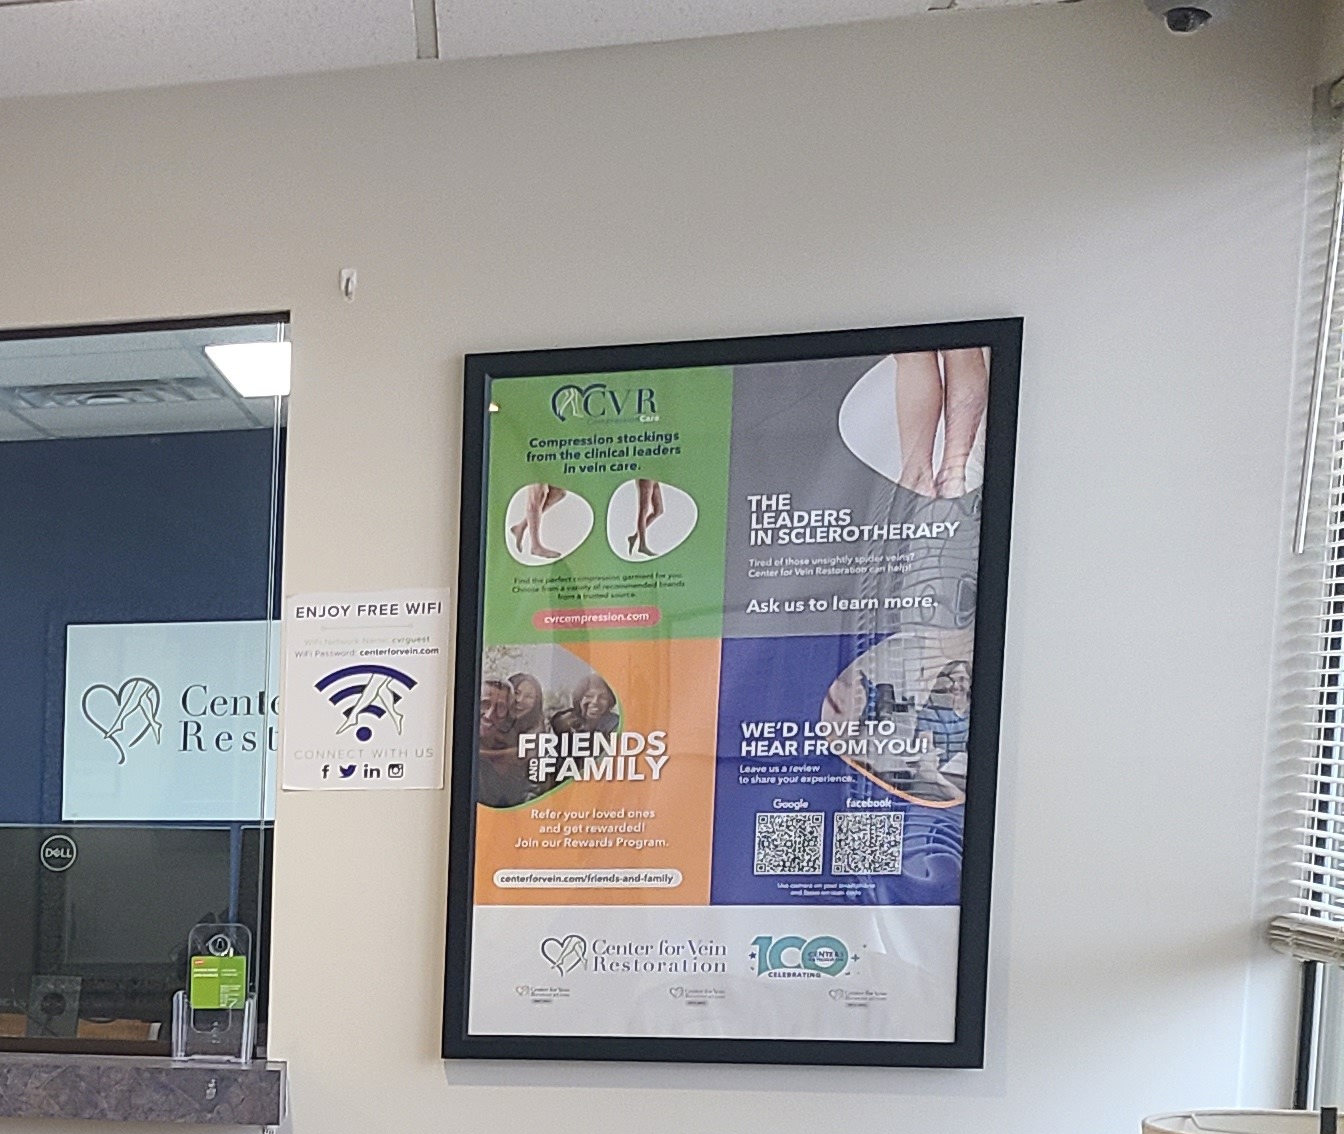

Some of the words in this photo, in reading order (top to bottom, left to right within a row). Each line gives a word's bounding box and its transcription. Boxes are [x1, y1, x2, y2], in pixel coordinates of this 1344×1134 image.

[583, 388, 657, 417] CVR
[529, 435, 613, 448] Compression
[617, 432, 679, 445] stockings
[527, 452, 556, 462] from
[560, 450, 580, 460] the
[585, 447, 629, 459] clinical
[633, 445, 681, 457] leaders
[564, 463, 575, 474] in
[579, 461, 606, 472] vein
[610, 462, 641, 472] care.
[747, 493, 791, 511] THE
[752, 509, 852, 529] LEADERS
[750, 530, 772, 545] IN
[778, 521, 960, 544] SCLEROTHERAPY
[749, 558, 772, 567] Tired
[775, 557, 783, 566] of
[785, 557, 809, 565] those
[812, 555, 853, 565] unsightly
[748, 569, 778, 577] Center
[781, 568, 792, 576] for
[795, 568, 813, 576] Vein
[816, 566, 866, 575] Restoration
[296, 605, 350, 618] ENJOY
[358, 604, 399, 616] FREE
[406, 601, 441, 614] WIFI
[746, 598, 780, 613] Ask
[785, 600, 804, 612] us
[809, 598, 827, 611] to
[833, 595, 879, 610] learn
[884, 596, 938, 608] more.
[544, 612, 649, 624] cvrcompression.com
[360, 647, 439, 656] centerforvein.com
[741, 722, 798, 738] WE'D
[804, 721, 860, 737] LOVE
[864, 720, 895, 736] TO
[518, 730, 667, 758] FRIENDS
[740, 741, 798, 757] HEAR
[804, 739, 866, 756] FROM
[874, 738, 928, 755] YOU!
[294, 749, 364, 759] CONNECT
[372, 749, 407, 758] WITH
[416, 749, 433, 758] US
[528, 758, 538, 782] AND
[538, 756, 669, 782] FAMILY
[740, 765, 766, 773] Leave
[789, 765, 820, 773] review
[751, 776, 776, 784] share
[778, 776, 799, 786] your
[801, 775, 855, 784] experience.
[773, 799, 809, 810] Google
[846, 798, 892, 808] facebook
[531, 809, 562, 820] Refer
[564, 811, 590, 821] your
[592, 808, 624, 819] loved
[628, 810, 655, 818] ones
[539, 823, 560, 833] and
[564, 823, 582, 835] get
[586, 822, 645, 833] rewarded!
[515, 838, 539, 848] Join
[542, 839, 562, 847] our
[564, 838, 612, 847] Rewards
[616, 838, 669, 850] Program.
[45, 848, 72, 858] DELL
[500, 874, 674, 884] centerforvein.com/friends-and-family
[592, 938, 653, 956] Center
[659, 938, 684, 955] for
[685, 938, 727, 955] Vein
[593, 957, 727, 973] Restoration
